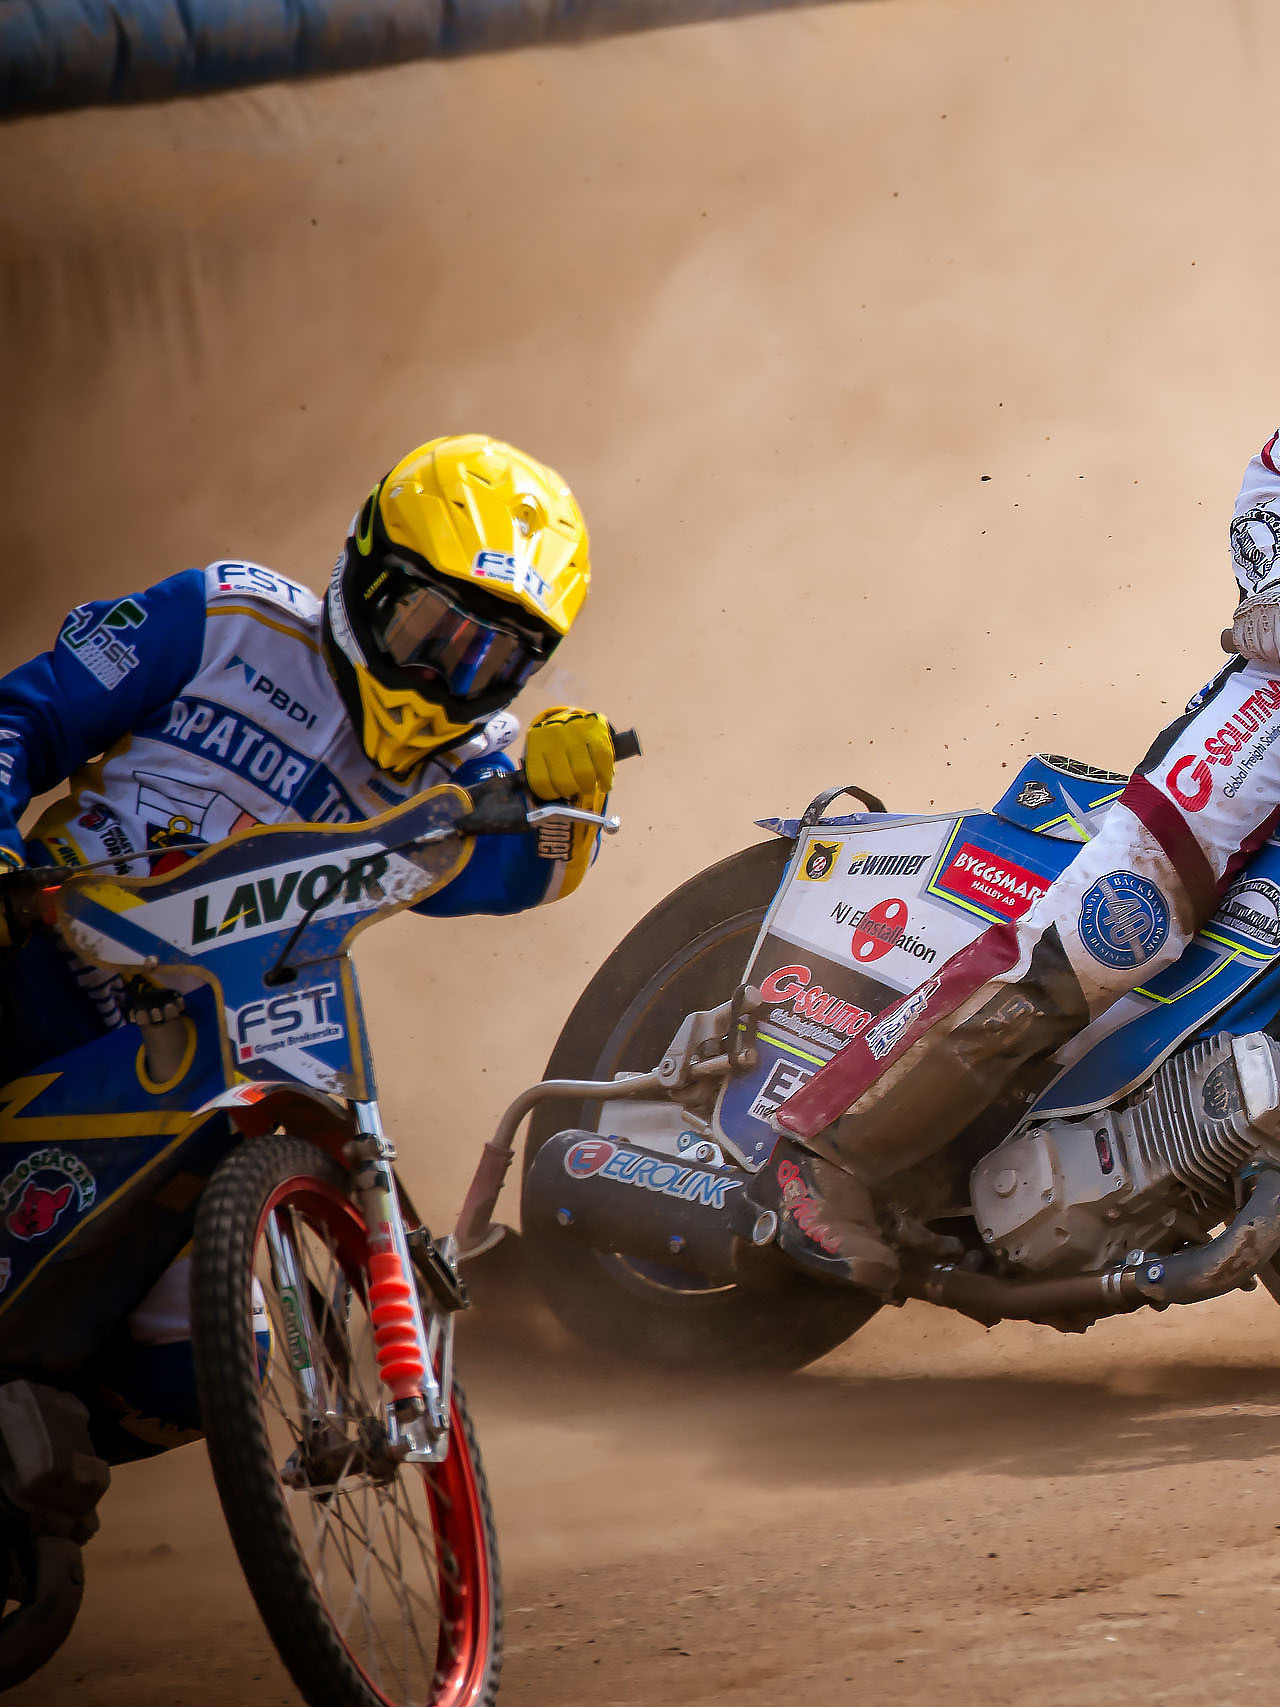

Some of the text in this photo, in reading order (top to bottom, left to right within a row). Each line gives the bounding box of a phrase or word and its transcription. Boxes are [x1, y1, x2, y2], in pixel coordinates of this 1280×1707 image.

[217, 564, 302, 603] FST
[253, 675, 318, 730] PBDI
[162, 700, 307, 800] APATOR
[1223, 764, 1249, 799] Global
[1242, 744, 1267, 772] Freight
[191, 855, 391, 946] LAVOR
[953, 852, 1047, 901] BYGGSMAR
[1001, 896, 1016, 906] AB
[829, 901, 853, 924] NJ
[237, 985, 335, 1044] FST
[760, 964, 878, 1036] G-SOLUTIO
[602, 1151, 743, 1208] EUROLINK
